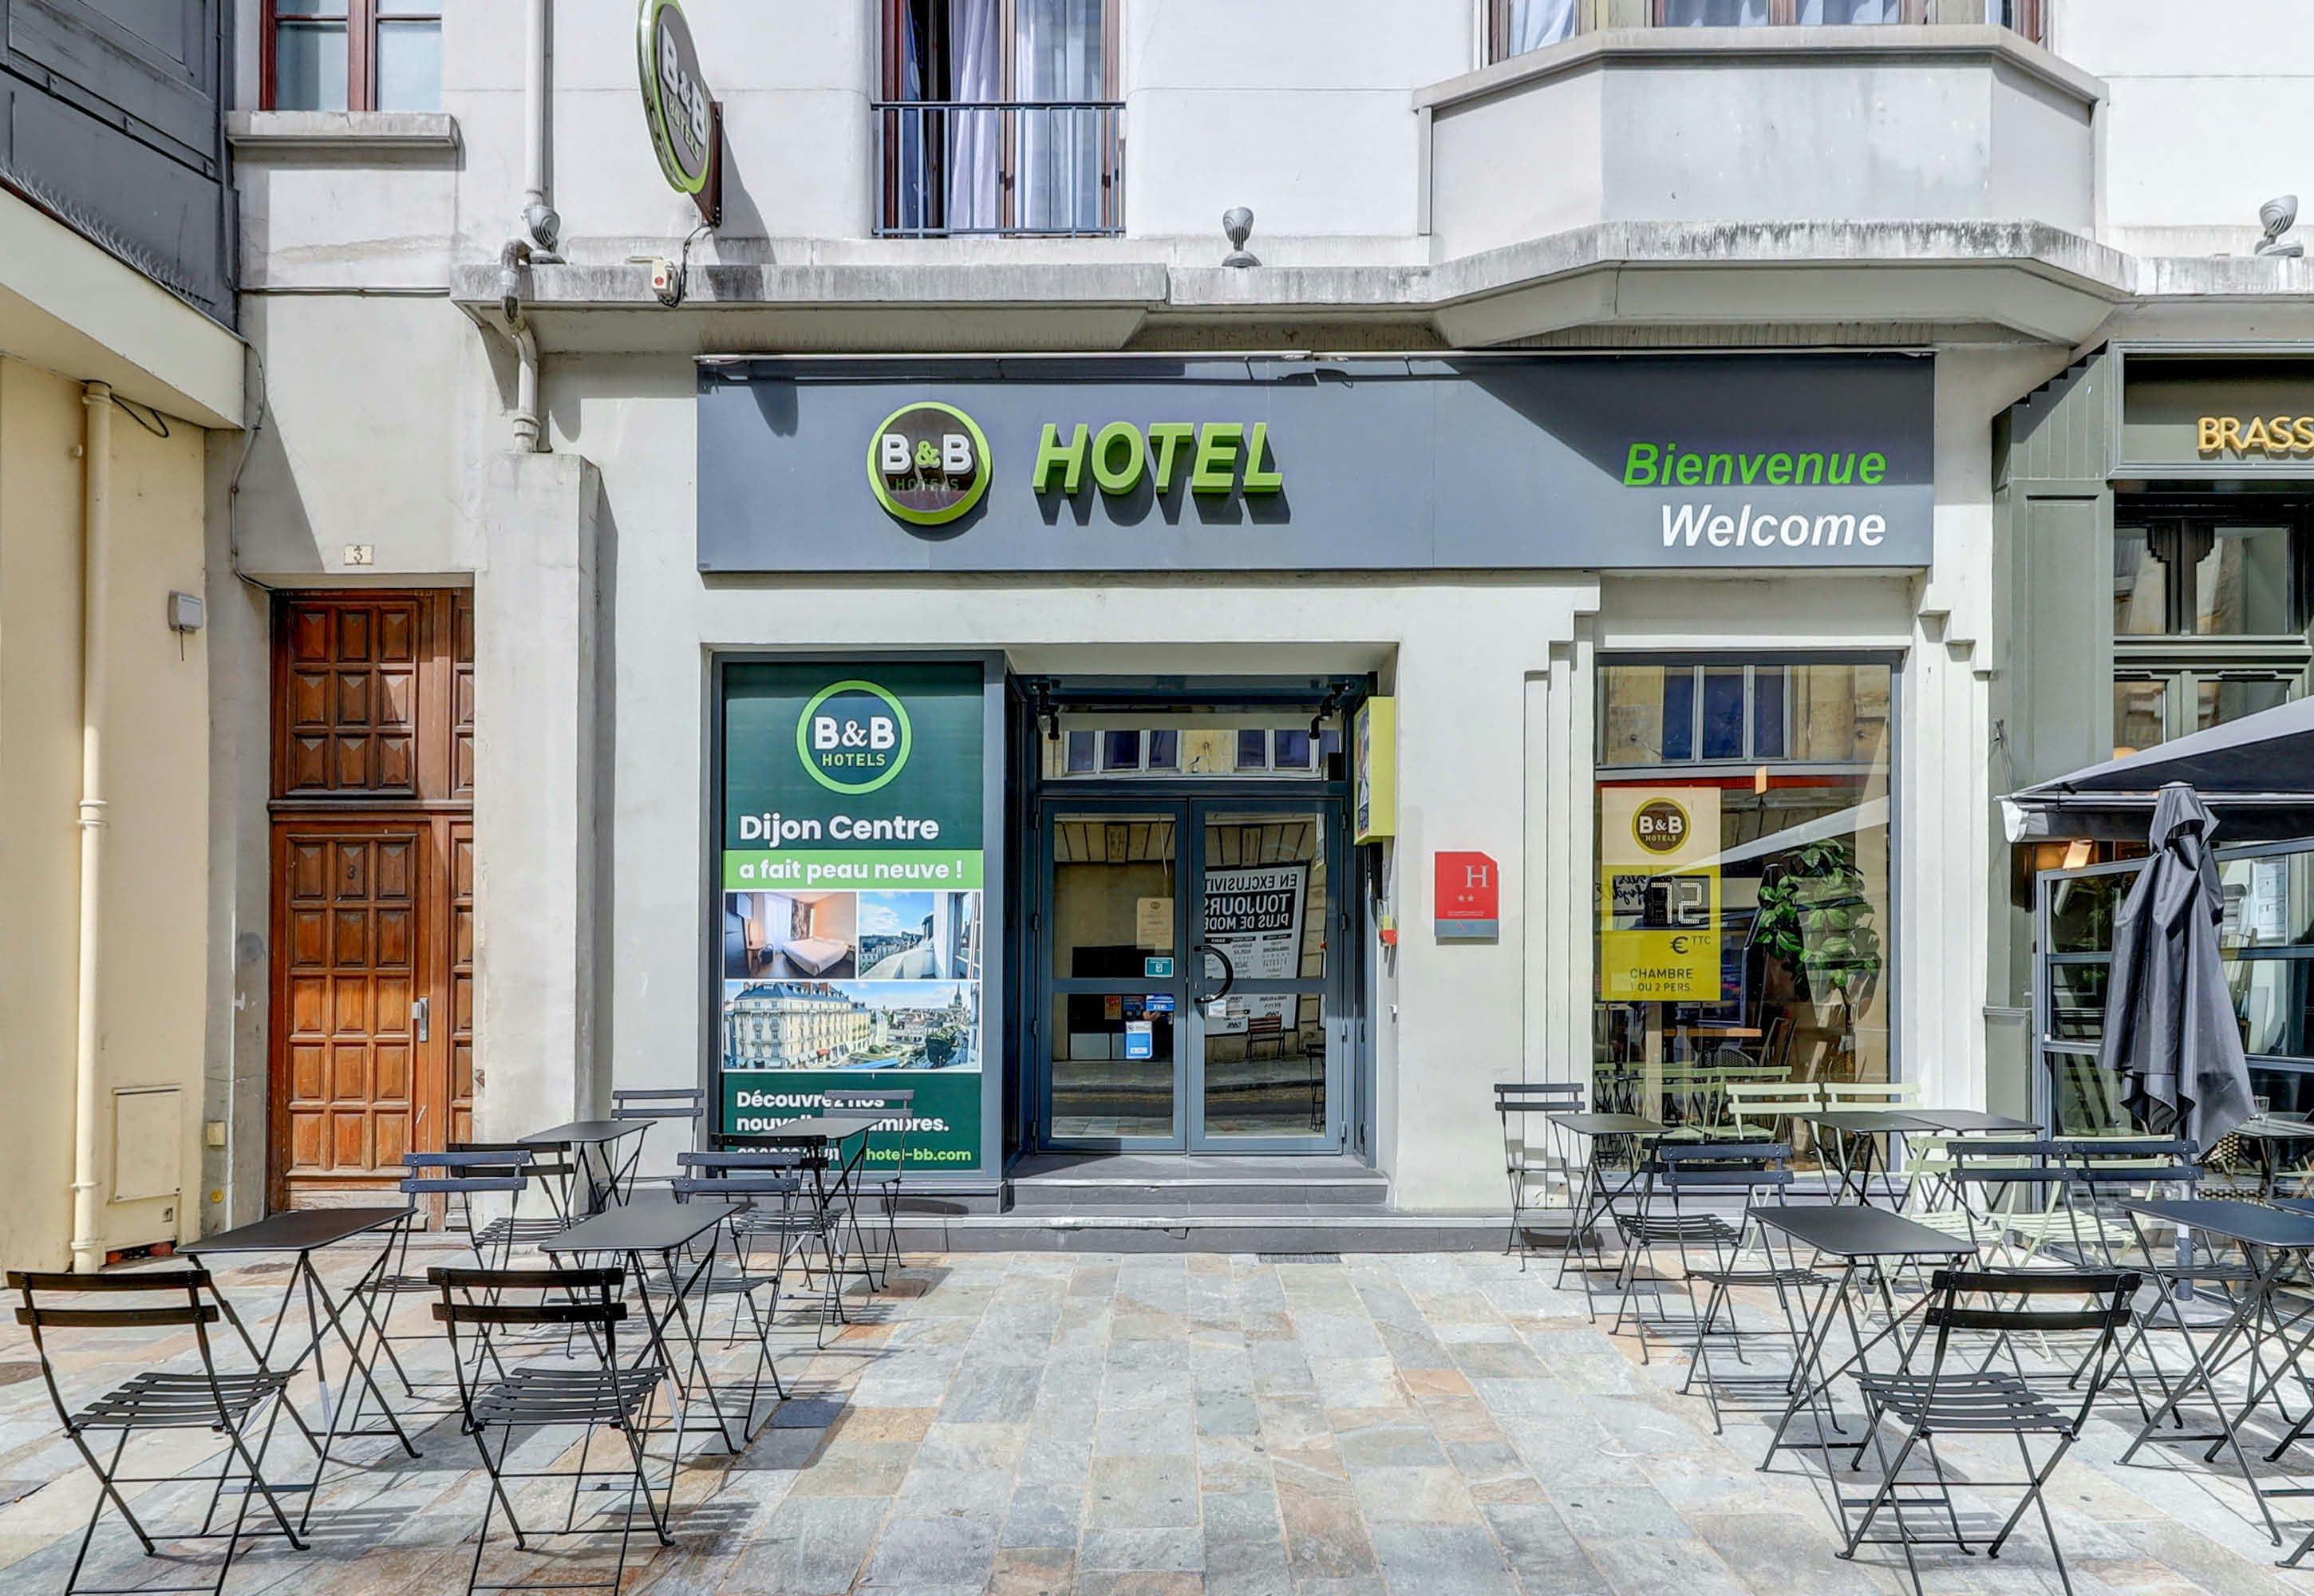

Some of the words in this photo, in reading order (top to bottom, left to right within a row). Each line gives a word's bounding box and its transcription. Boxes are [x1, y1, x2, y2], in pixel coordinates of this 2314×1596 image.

[660, 24, 705, 148] B&B
[667, 93, 700, 162] HOTELS
[2198, 416, 2314, 450] BRASS
[882, 433, 973, 475] B&B
[1032, 421, 1284, 494] HOTEL
[1623, 441, 1888, 487] Bienvenue
[1661, 503, 1886, 547] Welcome
[353, 547, 363, 563] 3
[814, 716, 895, 750] B&B
[821, 753, 886, 767] HOTELS
[739, 812, 822, 848] Dijon
[828, 815, 940, 840] Centre
[1639, 815, 1683, 836] B&B
[347, 863, 357, 880] 3
[739, 866, 755, 879] a
[760, 859, 801, 879] fait
[806, 866, 868, 886] peau
[874, 866, 950, 879] neuve
[956, 859, 963, 879] !
[1464, 865, 1490, 888] H
[1650, 882, 1702, 924] 72
[1669, 935, 1688, 954] €
[1692, 935, 1711, 946] TTC
[1630, 968, 1694, 979] CHAMBRE
[1637, 982, 1653, 991] OU
[1655, 982, 1660, 991] 2
[1664, 982, 1694, 991] PERS.
